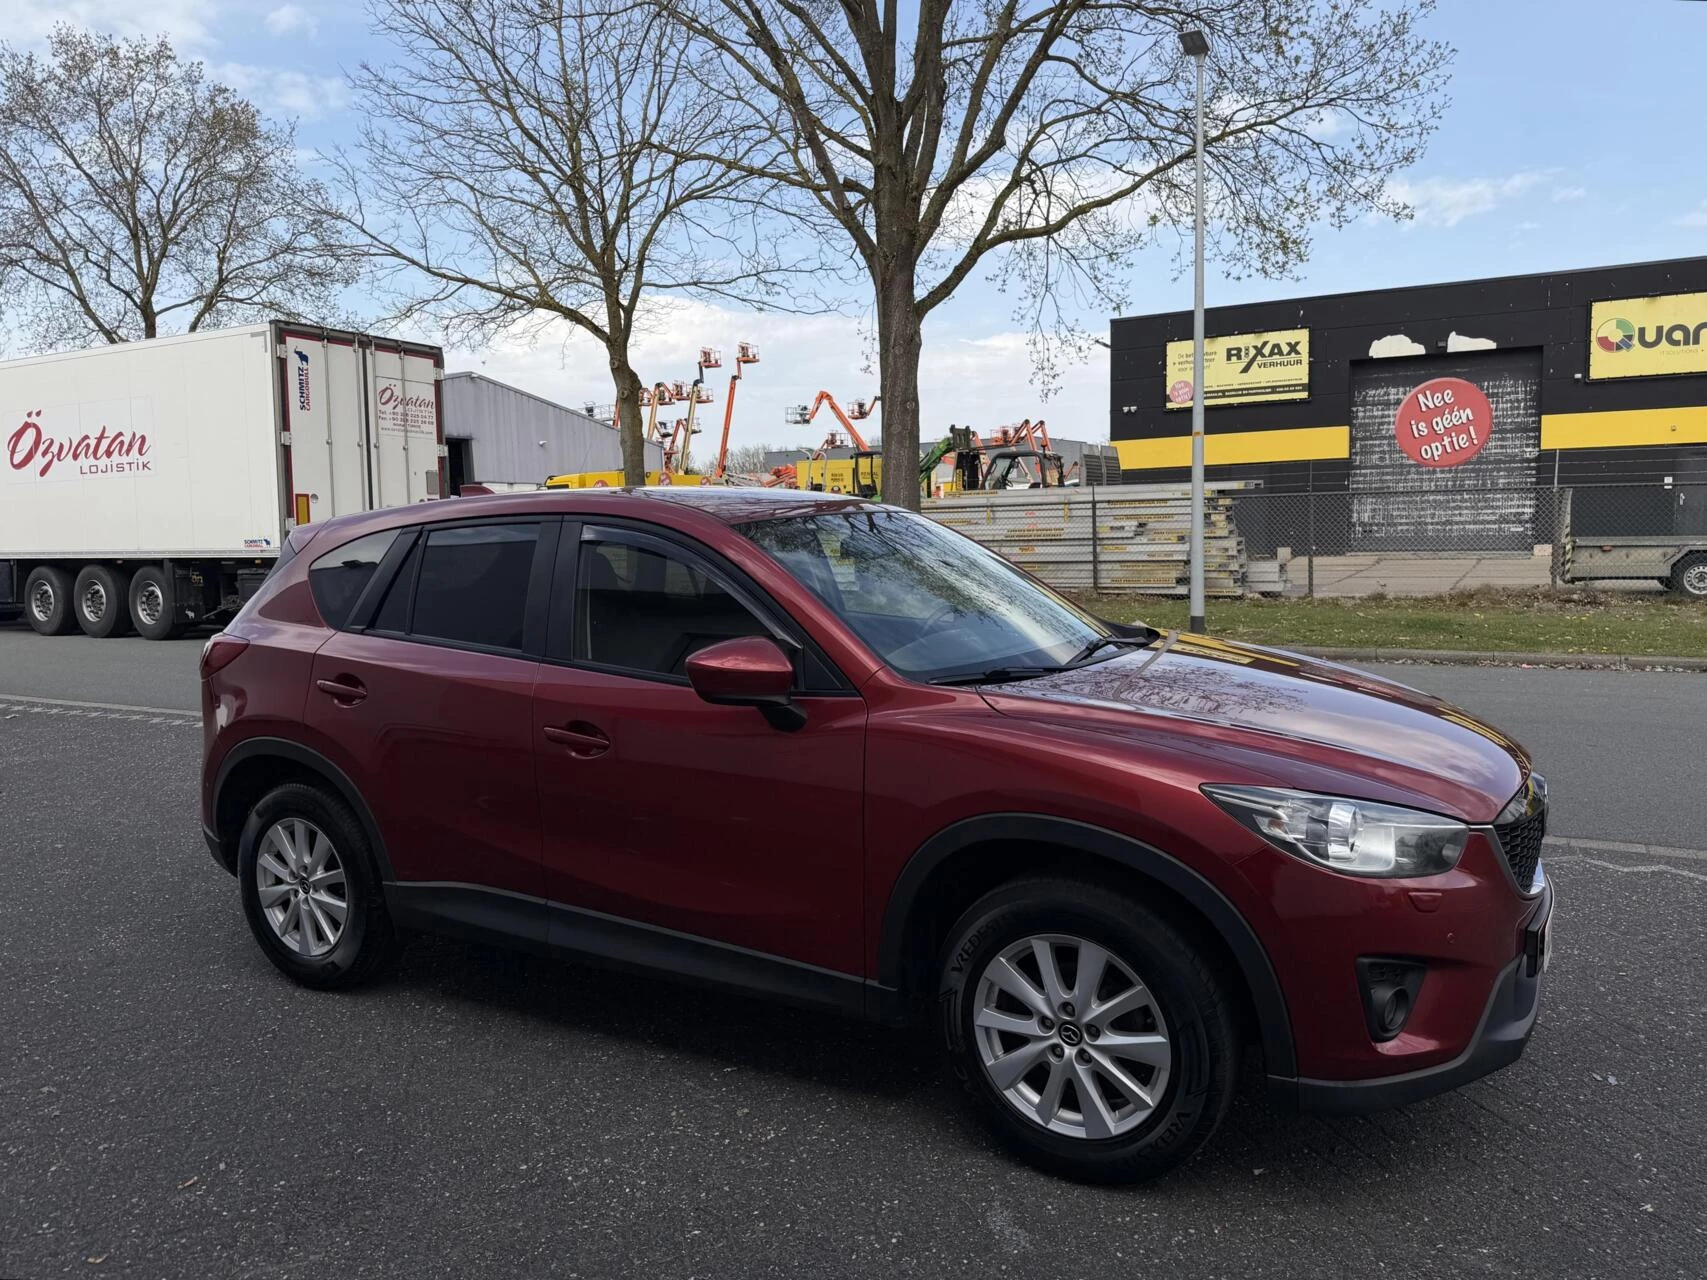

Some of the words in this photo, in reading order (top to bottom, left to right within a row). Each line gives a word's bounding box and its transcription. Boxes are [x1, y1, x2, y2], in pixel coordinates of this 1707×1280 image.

[1257, 359, 1303, 369] VERHUUR
[1417, 389, 1454, 411] Nee
[1410, 420, 1428, 438] is
[1432, 406, 1474, 434] géén
[7, 409, 151, 477] Özvatan
